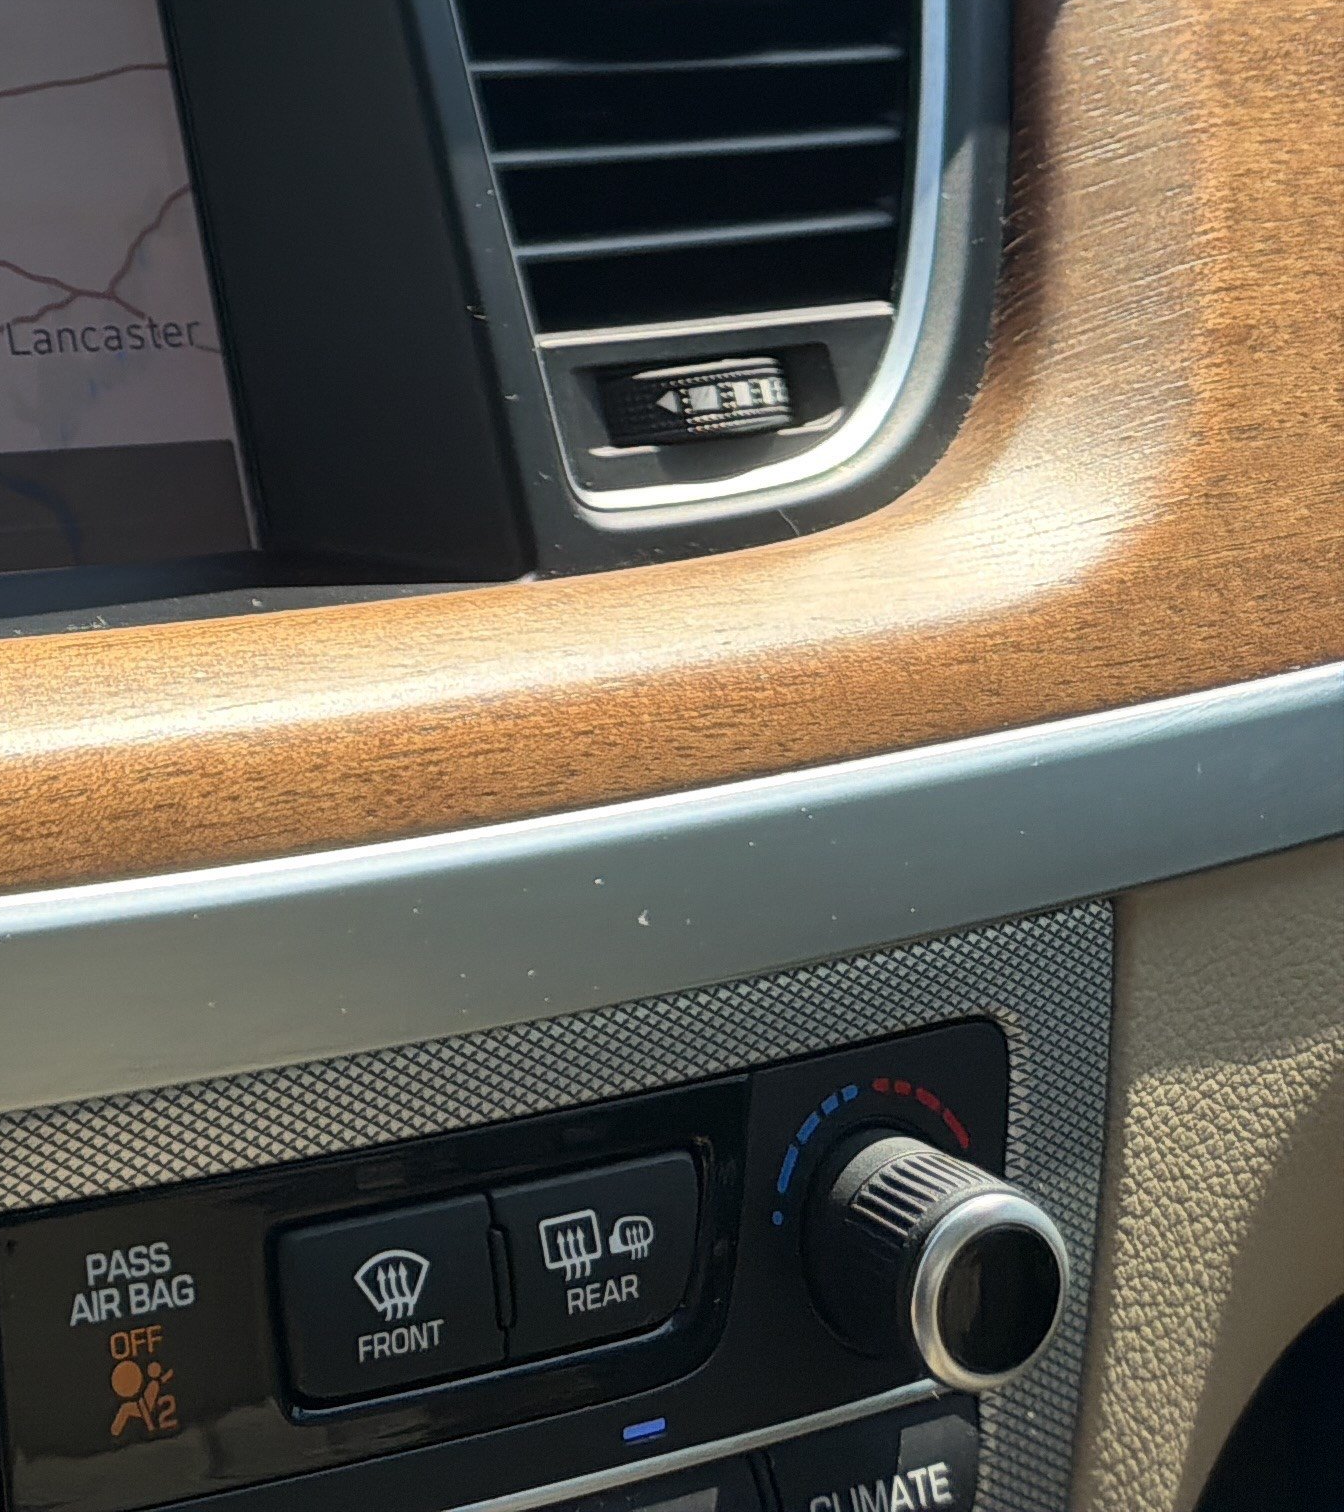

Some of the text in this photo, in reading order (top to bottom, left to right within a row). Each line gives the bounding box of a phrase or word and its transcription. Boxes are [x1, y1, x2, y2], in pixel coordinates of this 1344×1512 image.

[8, 316, 200, 357] Lancaster
[85, 1241, 172, 1287] PASS
[69, 1274, 195, 1327] AIR BAG
[566, 1274, 640, 1316] REAR
[109, 1324, 164, 1360] OFF
[357, 1318, 445, 1363] FRONT
